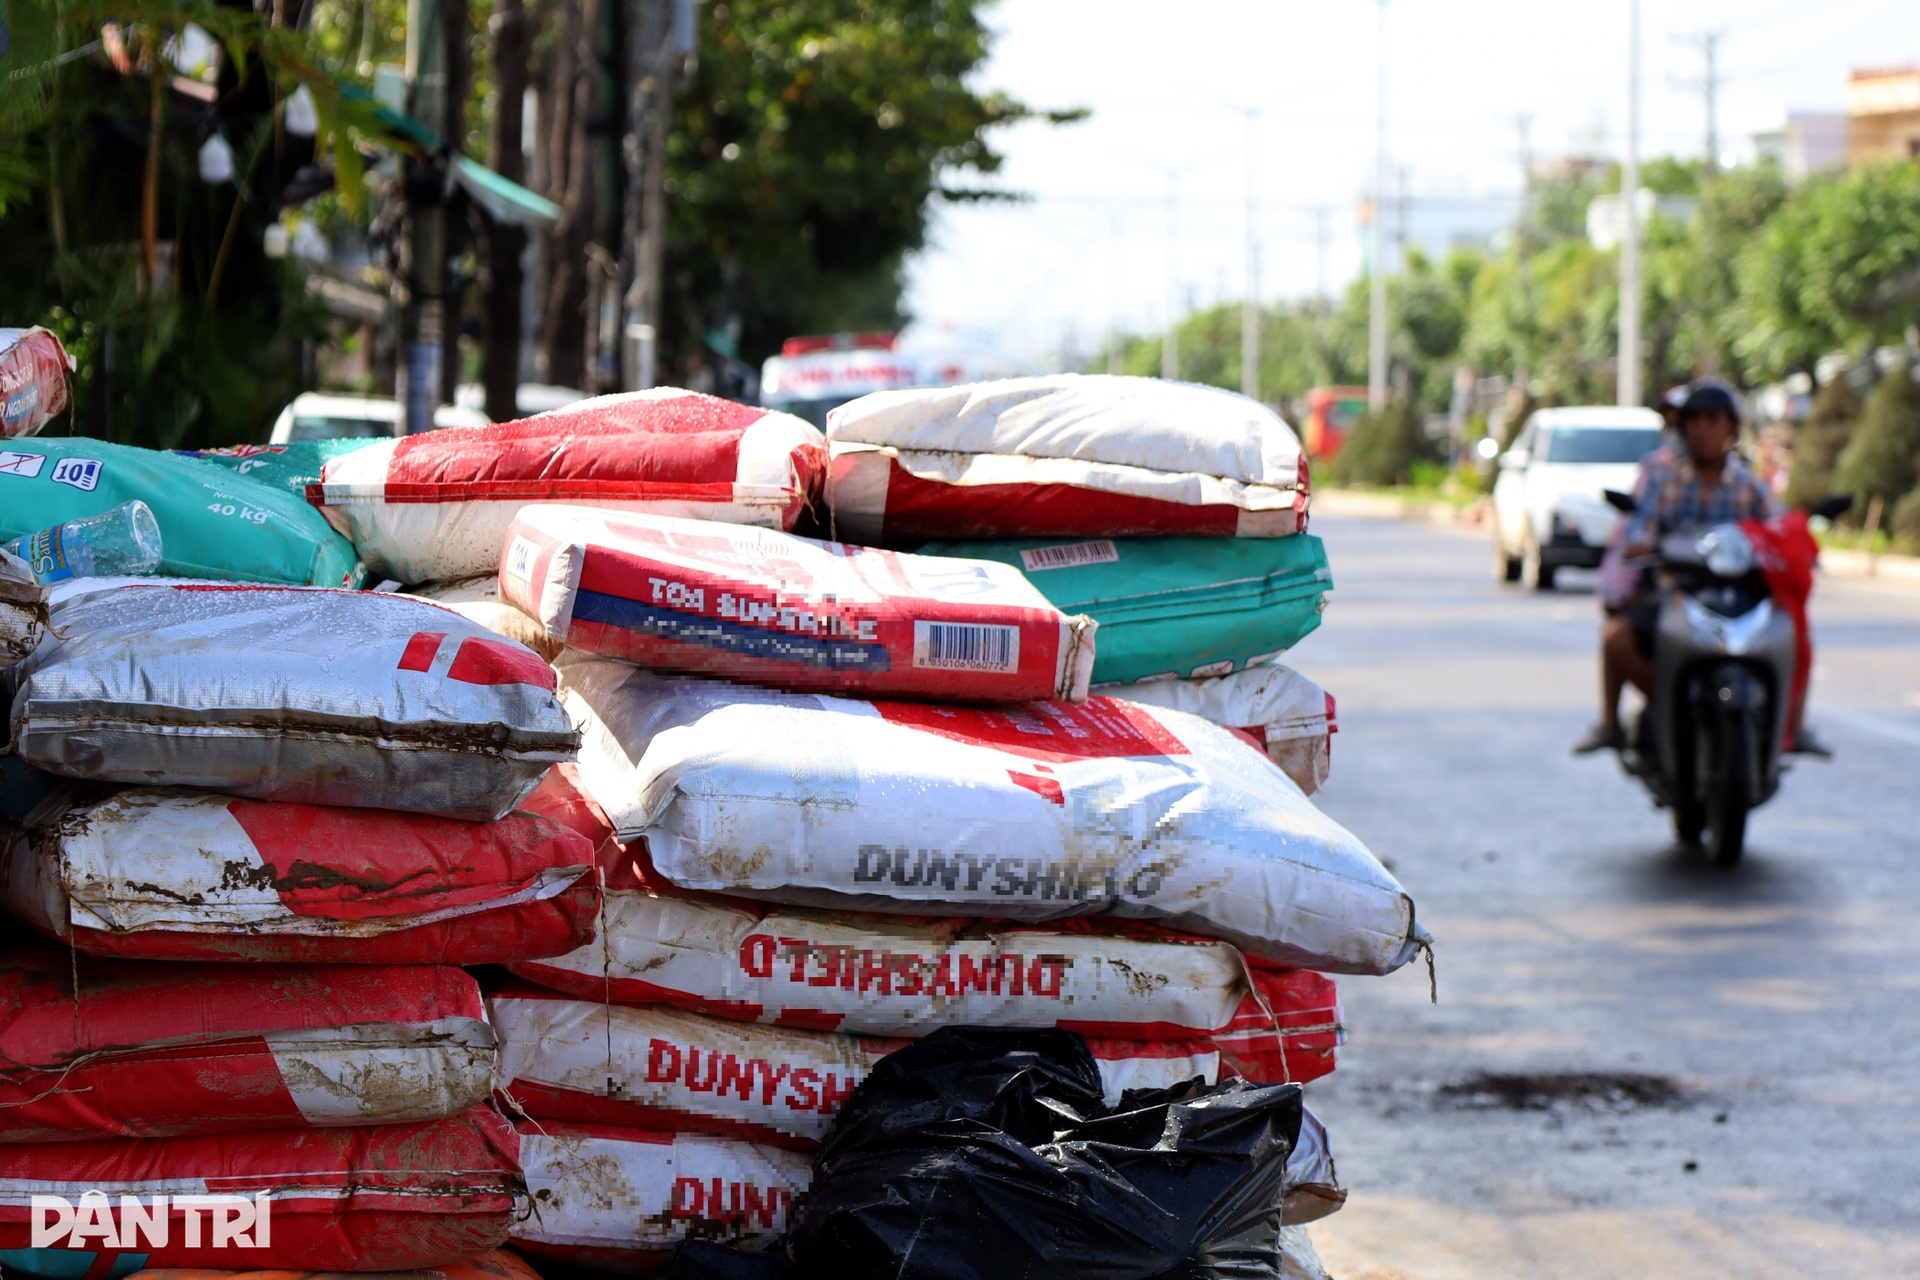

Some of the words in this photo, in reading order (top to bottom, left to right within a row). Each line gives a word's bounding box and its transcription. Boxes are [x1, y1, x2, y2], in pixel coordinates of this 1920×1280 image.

[57, 463, 82, 482] 10
[207, 503, 236, 516] 40
[240, 506, 268, 525] kg
[648, 576, 704, 613] TOA
[919, 657, 925, 666] 8
[670, 1176, 793, 1230] DUN
